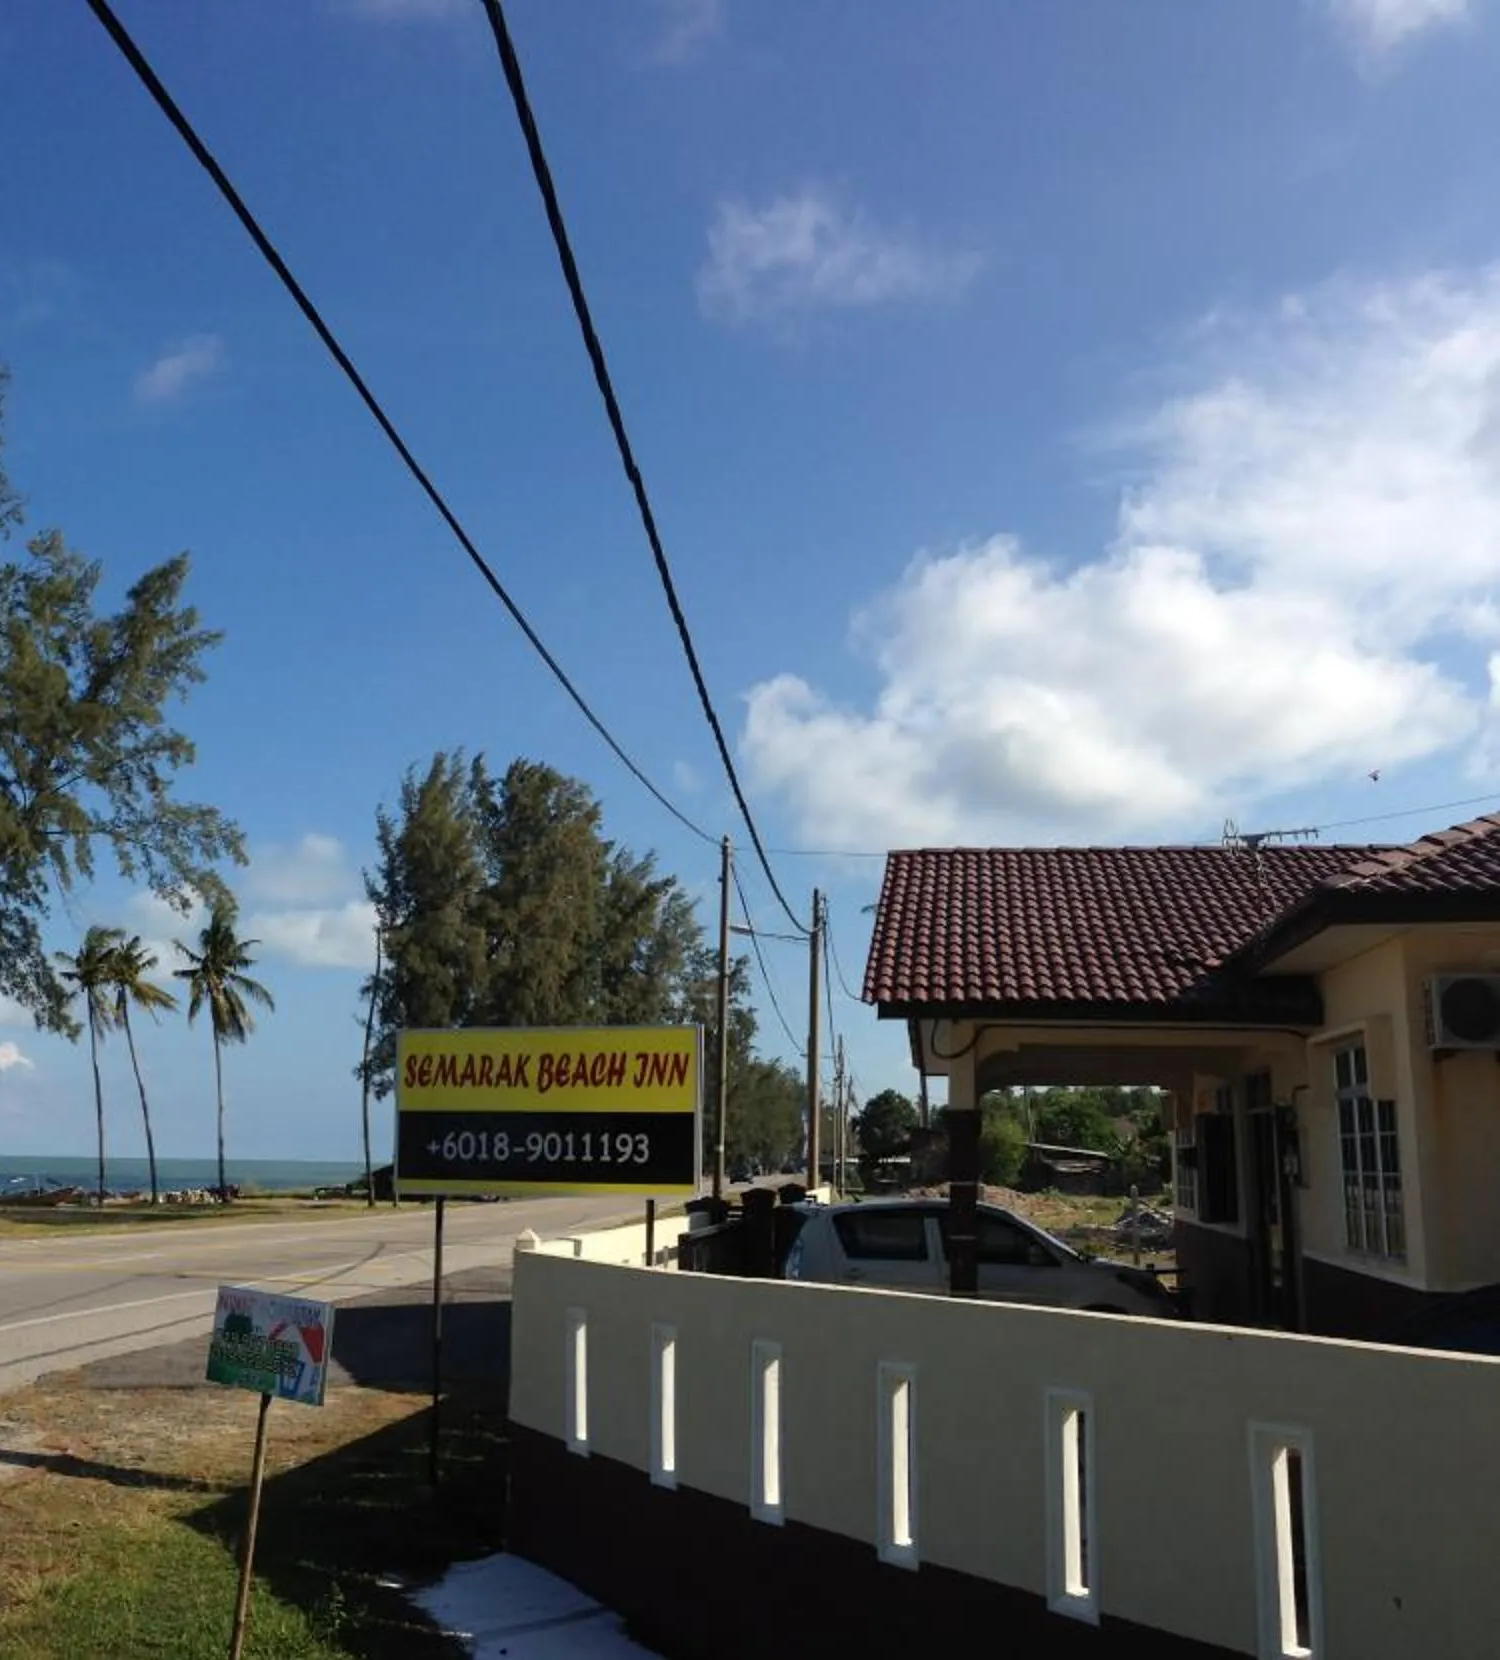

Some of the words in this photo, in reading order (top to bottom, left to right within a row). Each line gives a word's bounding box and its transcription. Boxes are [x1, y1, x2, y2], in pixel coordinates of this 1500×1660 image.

[404, 1053, 531, 1089] SEMARAK
[537, 1052, 627, 1093] BEACH
[633, 1052, 690, 1088] INN
[427, 1131, 650, 1164] +6018-9011193
